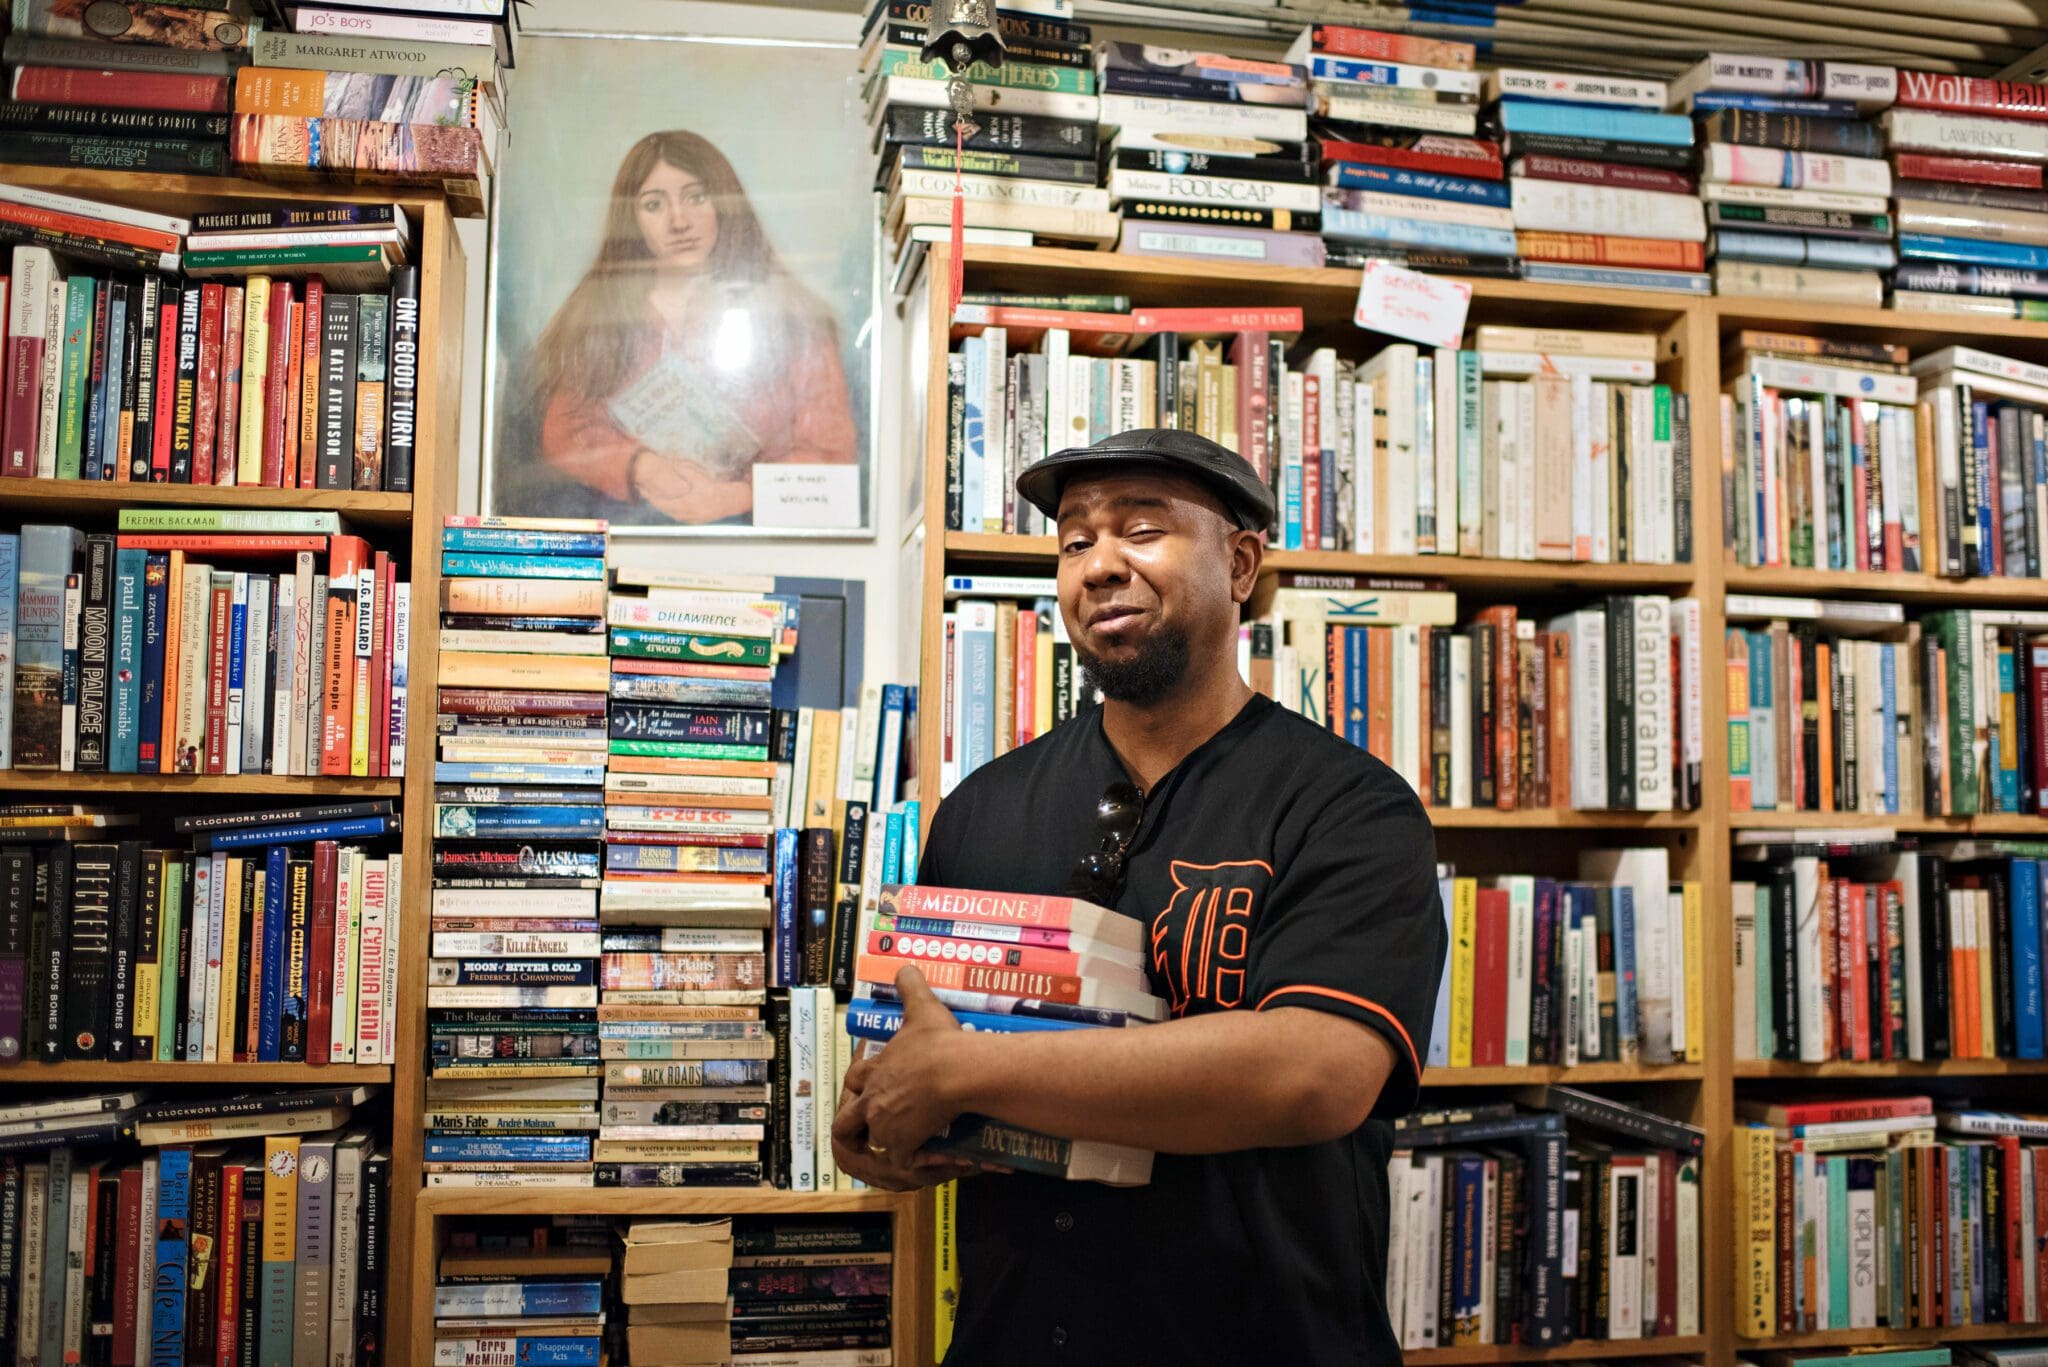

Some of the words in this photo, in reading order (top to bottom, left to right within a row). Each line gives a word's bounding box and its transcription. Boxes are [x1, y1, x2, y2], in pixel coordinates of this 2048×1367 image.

[311, 14, 335, 28] JO'S
[340, 17, 373, 30] BOYS
[296, 44, 366, 60] MARGARET
[369, 49, 427, 64] ATWOOD
[1903, 70, 1973, 107] Wolf
[1996, 80, 2047, 112] Hall
[48, 109, 97, 125] MURTHER
[111, 112, 154, 129] WALKING
[157, 115, 197, 132] SPIRITS
[1939, 127, 2016, 147] LAWRENCE
[84, 154, 134, 167] DAVIES
[1168, 177, 1275, 203] FOOLSCAP
[199, 214, 239, 229] MARGARET
[241, 212, 272, 226] ATWOOD
[290, 211, 312, 224] ORYX
[327, 209, 352, 222] CRAKE
[22, 258, 36, 296] Dorothy
[20, 298, 33, 335] Allison
[181, 289, 200, 333] WHITE
[329, 314, 349, 323] LIFE
[395, 297, 417, 333] ONE
[179, 333, 196, 370] GIRLS
[328, 332, 348, 341] LIFE
[16, 338, 31, 398] Cavedweller
[329, 348, 345, 382] KATE
[393, 341, 416, 388] GOOD
[88, 394, 99, 423] NIGHT
[176, 379, 193, 422] HILTON
[174, 425, 191, 451] ALS
[326, 388, 343, 456] ATKINSON
[391, 399, 415, 448] TURN
[87, 428, 97, 457] TRAIN
[125, 516, 165, 526] FREDRIK
[168, 516, 216, 527] BACKMAN
[119, 576, 140, 610] paul
[360, 578, 372, 599] J.G.
[83, 606, 108, 662] MOON
[147, 592, 160, 645] azevedo
[358, 602, 371, 652] BALLARD
[396, 611, 407, 652] BALLARD
[119, 615, 134, 664] auster
[333, 608, 344, 667] Millennium
[232, 659, 241, 682] Baker
[80, 667, 105, 735] PALACE
[331, 668, 342, 711] People
[531, 697, 575, 707] STENDHAL
[1638, 602, 1662, 793] Glamorama
[116, 686, 133, 740] invisible
[389, 696, 404, 748] TIME
[694, 714, 719, 726] IAIN
[688, 724, 725, 737] PEARS
[464, 786, 500, 795] OLIVER
[195, 814, 257, 827] CLOCKWORK
[261, 811, 302, 821] ORANGE
[318, 807, 353, 817] BURGESS
[218, 834, 240, 842] THE
[241, 829, 307, 841] SHELTERING
[309, 826, 330, 834] SKY
[443, 850, 469, 865] James
[479, 850, 520, 865] Michener
[533, 850, 579, 866] ALASKA
[34, 863, 49, 904] WATT
[291, 865, 308, 927] BEAUTIFUL
[338, 881, 349, 908] SEX
[72, 862, 111, 953] BECKETT
[143, 862, 157, 952] BECKETT
[336, 909, 348, 937] DRUGS
[922, 894, 1030, 920] MEDICINE
[336, 937, 346, 961] ROCK
[505, 938, 536, 954] KILLER
[536, 938, 568, 954] ANGELS
[50, 950, 61, 991] ECHO'S
[116, 949, 127, 990] ECHO'S
[288, 928, 305, 999] CHILDREN
[463, 962, 498, 973] MOON
[506, 962, 550, 973] BITTER
[551, 962, 583, 973] COLD
[469, 973, 511, 983] FREDERICK
[520, 973, 577, 983] CHIAVENTONE
[335, 969, 344, 998] ROLL
[385, 967, 396, 1009] Bogosian
[968, 966, 1053, 997] ENCOUNTERS
[48, 993, 60, 1031] BONES
[114, 992, 125, 1030] BONES
[444, 1011, 465, 1022] The
[466, 1011, 503, 1022] Reader
[717, 1009, 747, 1018] PEARS
[856, 1012, 882, 1029] THE
[641, 1067, 664, 1086] BACK
[667, 1065, 702, 1086] ROADS
[157, 1105, 218, 1117] CLOCKWORK
[222, 1102, 264, 1113] ORANGE
[432, 1114, 464, 1129] Man's
[465, 1114, 489, 1128] Fate
[496, 1116, 522, 1129] André
[522, 1117, 557, 1129] Malraux
[185, 1122, 215, 1139] REBEL
[982, 1125, 1031, 1157] DOCTOR
[1031, 1136, 1059, 1164] MAX
[5, 1165, 16, 1187] THE
[228, 1172, 239, 1193] WE
[2, 1188, 16, 1240] PERSIAN
[195, 1177, 205, 1229] STATION
[206, 1170, 216, 1235] SHANGHAI
[227, 1194, 238, 1233] NEED
[339, 1204, 349, 1222] HIS
[368, 1182, 377, 1222] AUGUSTEN
[127, 1204, 138, 1247] MASTER
[0, 1242, 13, 1278] BRIDE
[225, 1234, 236, 1266] NEW
[338, 1225, 349, 1266] BLOODY
[367, 1224, 377, 1271] BURROUGHS
[1855, 1207, 1874, 1288] KIPLING
[124, 1265, 136, 1329] MARGARITA
[223, 1267, 235, 1317] NAMES
[304, 1270, 320, 1336] BURGESS
[337, 1268, 347, 1311] PROJECT
[465, 1352, 515, 1367] McMillan
[475, 1339, 506, 1354] Terry
[537, 1342, 585, 1354] Disappearing
[552, 1352, 569, 1361] Acts
